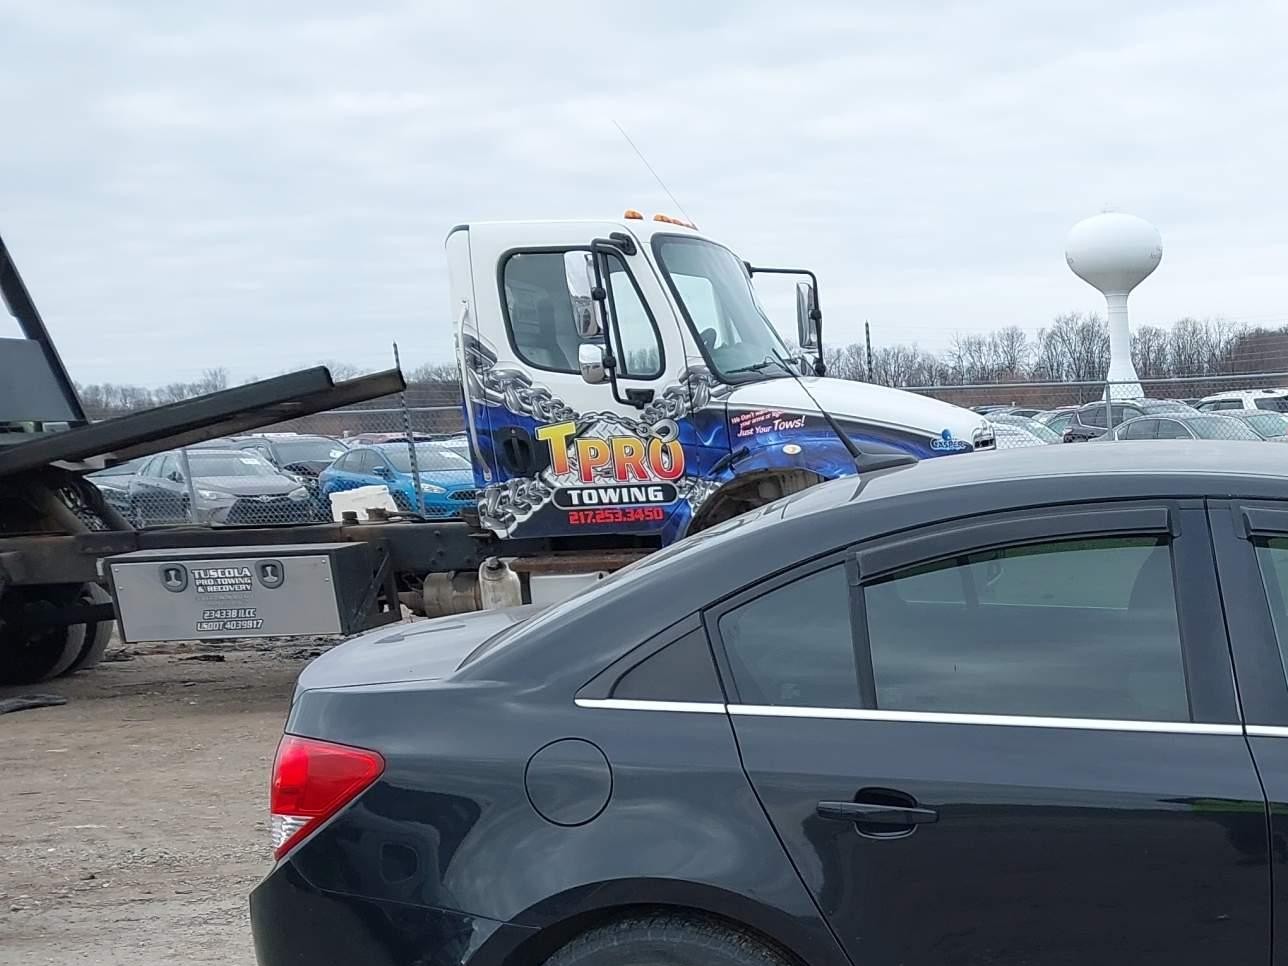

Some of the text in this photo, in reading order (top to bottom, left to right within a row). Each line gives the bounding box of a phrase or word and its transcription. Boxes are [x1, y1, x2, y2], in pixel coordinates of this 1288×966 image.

[737, 415, 806, 437] Just Your Tows!
[567, 486, 664, 506] TOWING
[568, 507, 664, 525] 217.253.3450
[191, 567, 252, 579] TUSCOLA
[215, 577, 251, 585] TOWING
[206, 584, 251, 592] RECOVERY
[197, 621, 224, 631] USDOT
